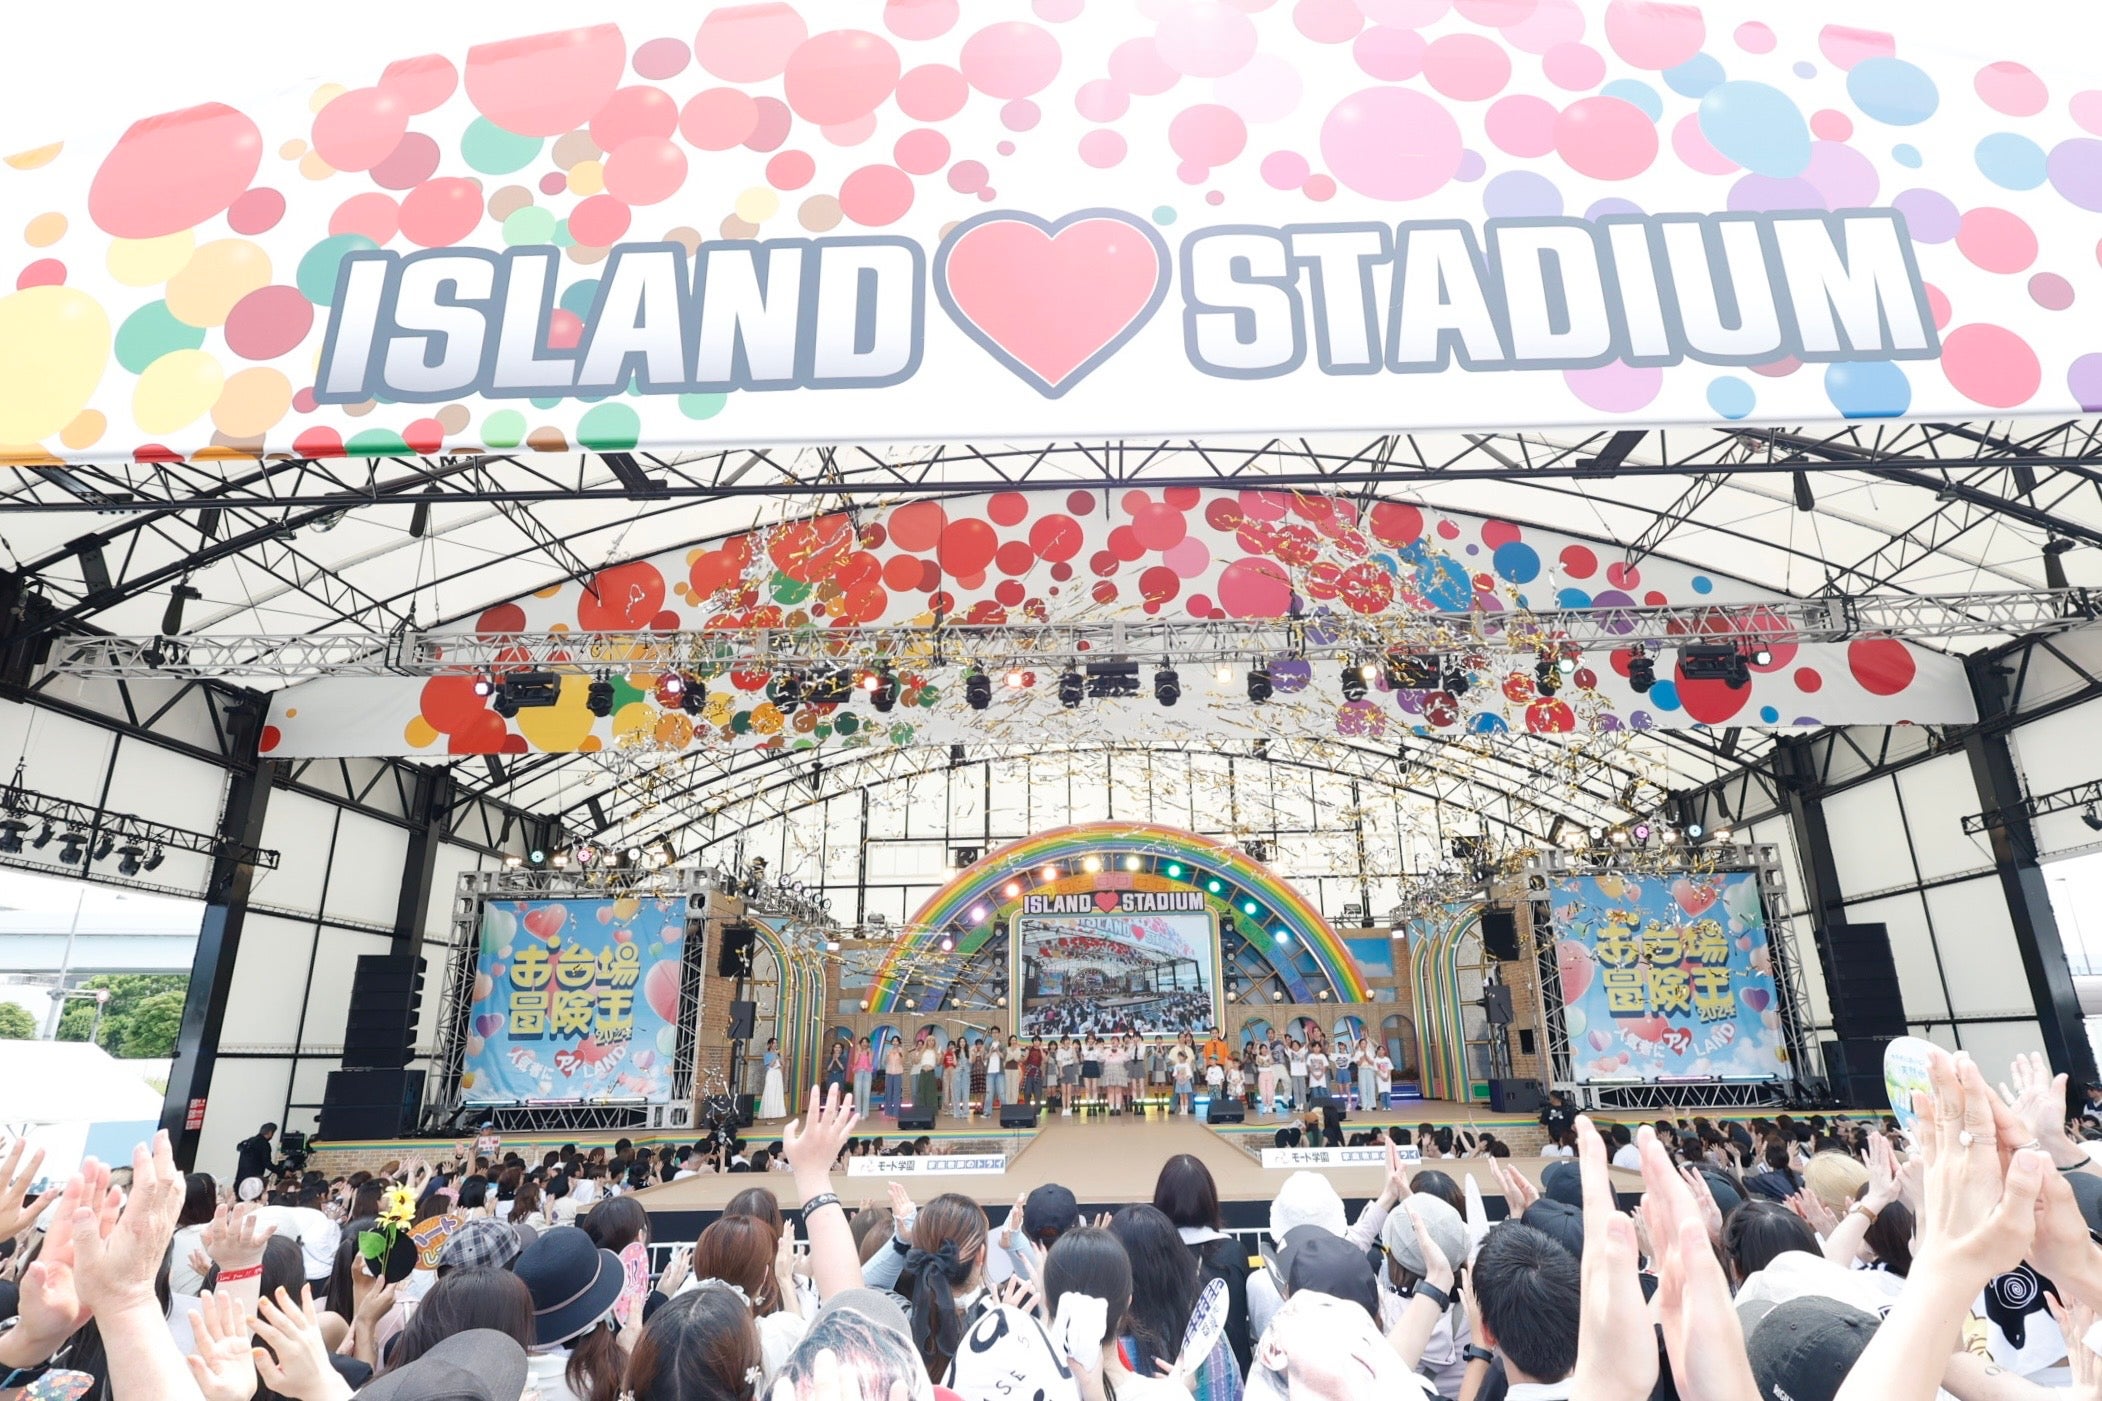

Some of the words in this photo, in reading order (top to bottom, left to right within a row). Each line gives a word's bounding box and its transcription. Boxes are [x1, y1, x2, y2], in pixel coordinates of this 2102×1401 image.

[316, 236, 925, 402] ISLAND
[1181, 208, 1942, 379] STADIUM
[1023, 894, 1092, 914] ISLAND
[1121, 892, 1205, 911] STADIUM
[1596, 912, 1729, 968] お台場
[510, 935, 640, 990] お台場
[1699, 1005, 1737, 1024] 2024
[595, 1027, 633, 1046] 2024
[1693, 1022, 1735, 1056] LAND
[583, 1046, 626, 1078] LAND
[1291, 1151, 1330, 1163] モード学園
